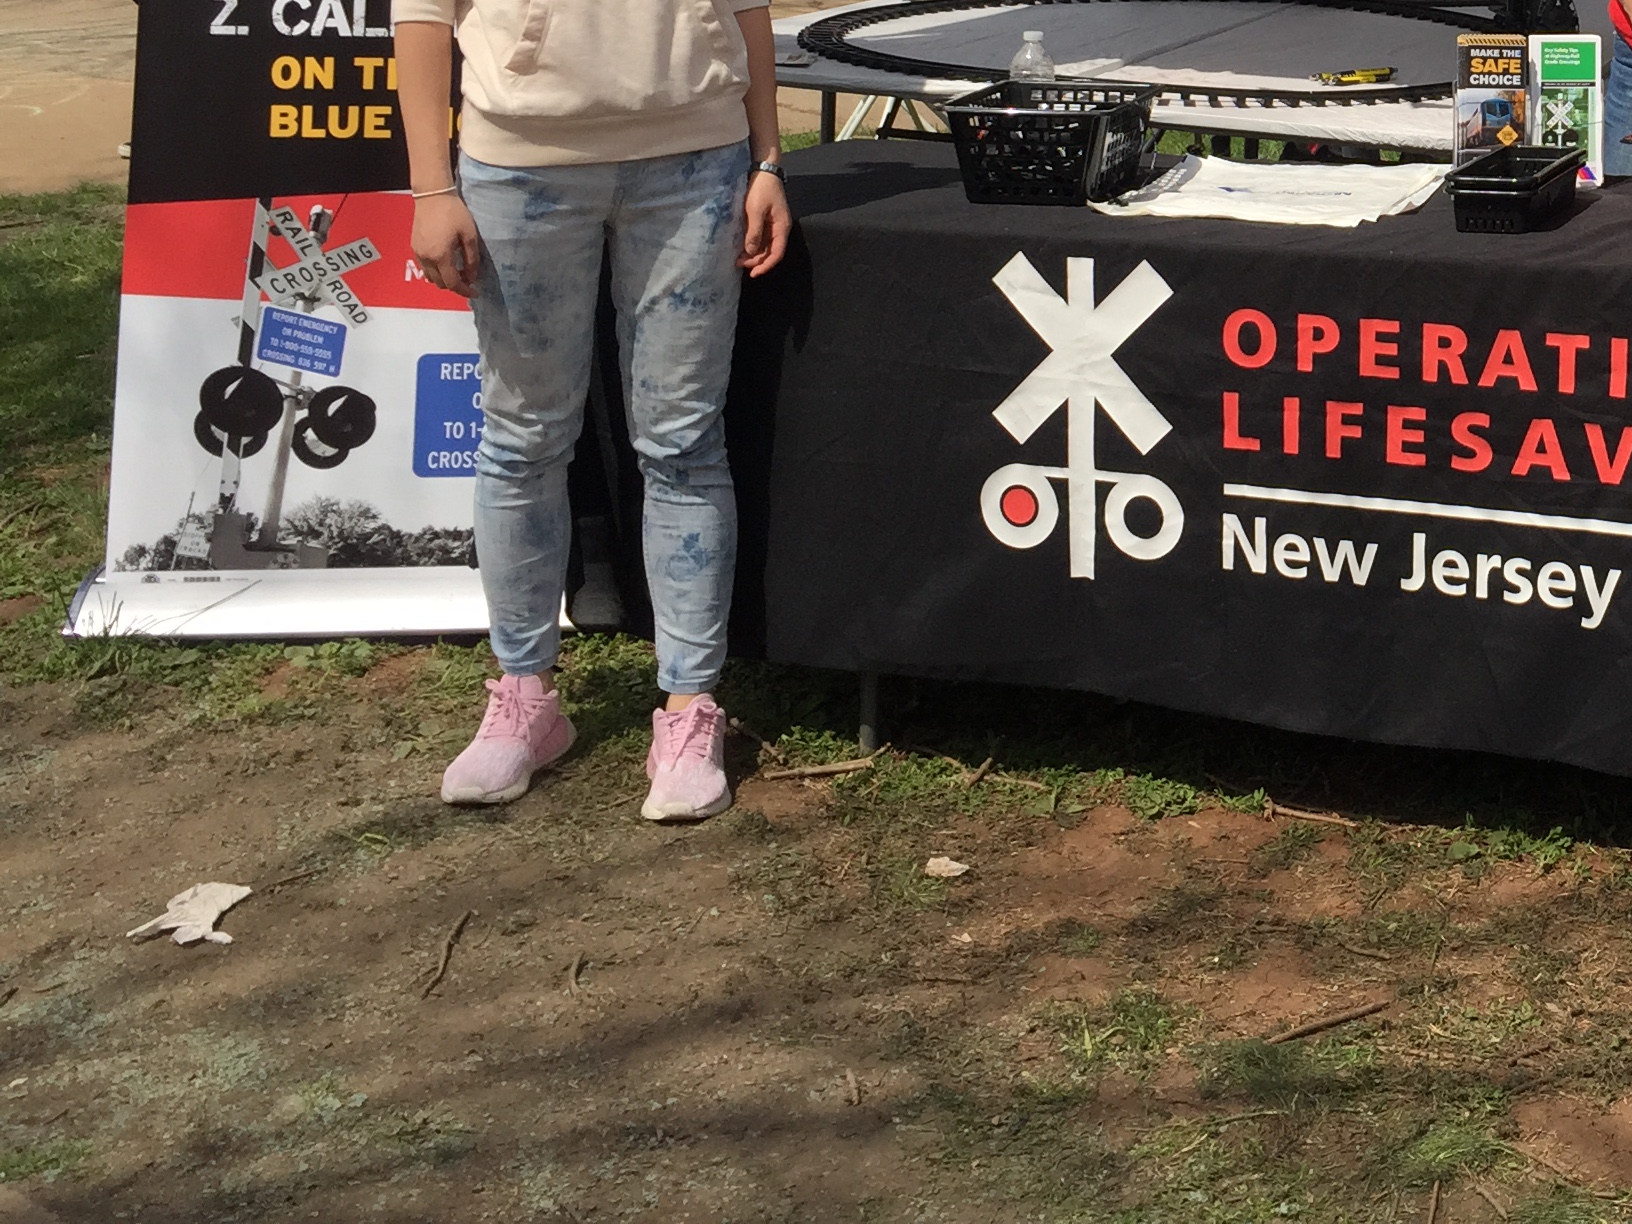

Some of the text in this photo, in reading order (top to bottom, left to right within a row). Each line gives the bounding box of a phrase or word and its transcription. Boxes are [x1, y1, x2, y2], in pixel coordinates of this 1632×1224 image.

[1470, 48, 1521, 57] MAKE THE
[271, 57, 334, 91] ON
[1470, 58, 1522, 74] SAFE
[1470, 74, 1521, 85] CHOICE
[269, 105, 392, 139] BLUE
[276, 210, 314, 257] RAIL
[270, 243, 373, 295] CROSSING
[326, 279, 368, 325] ROAD
[440, 363, 483, 380] REPO
[443, 422, 464, 439] TO
[427, 451, 480, 469] CROSS
[1221, 512, 1622, 629] New Jersey
